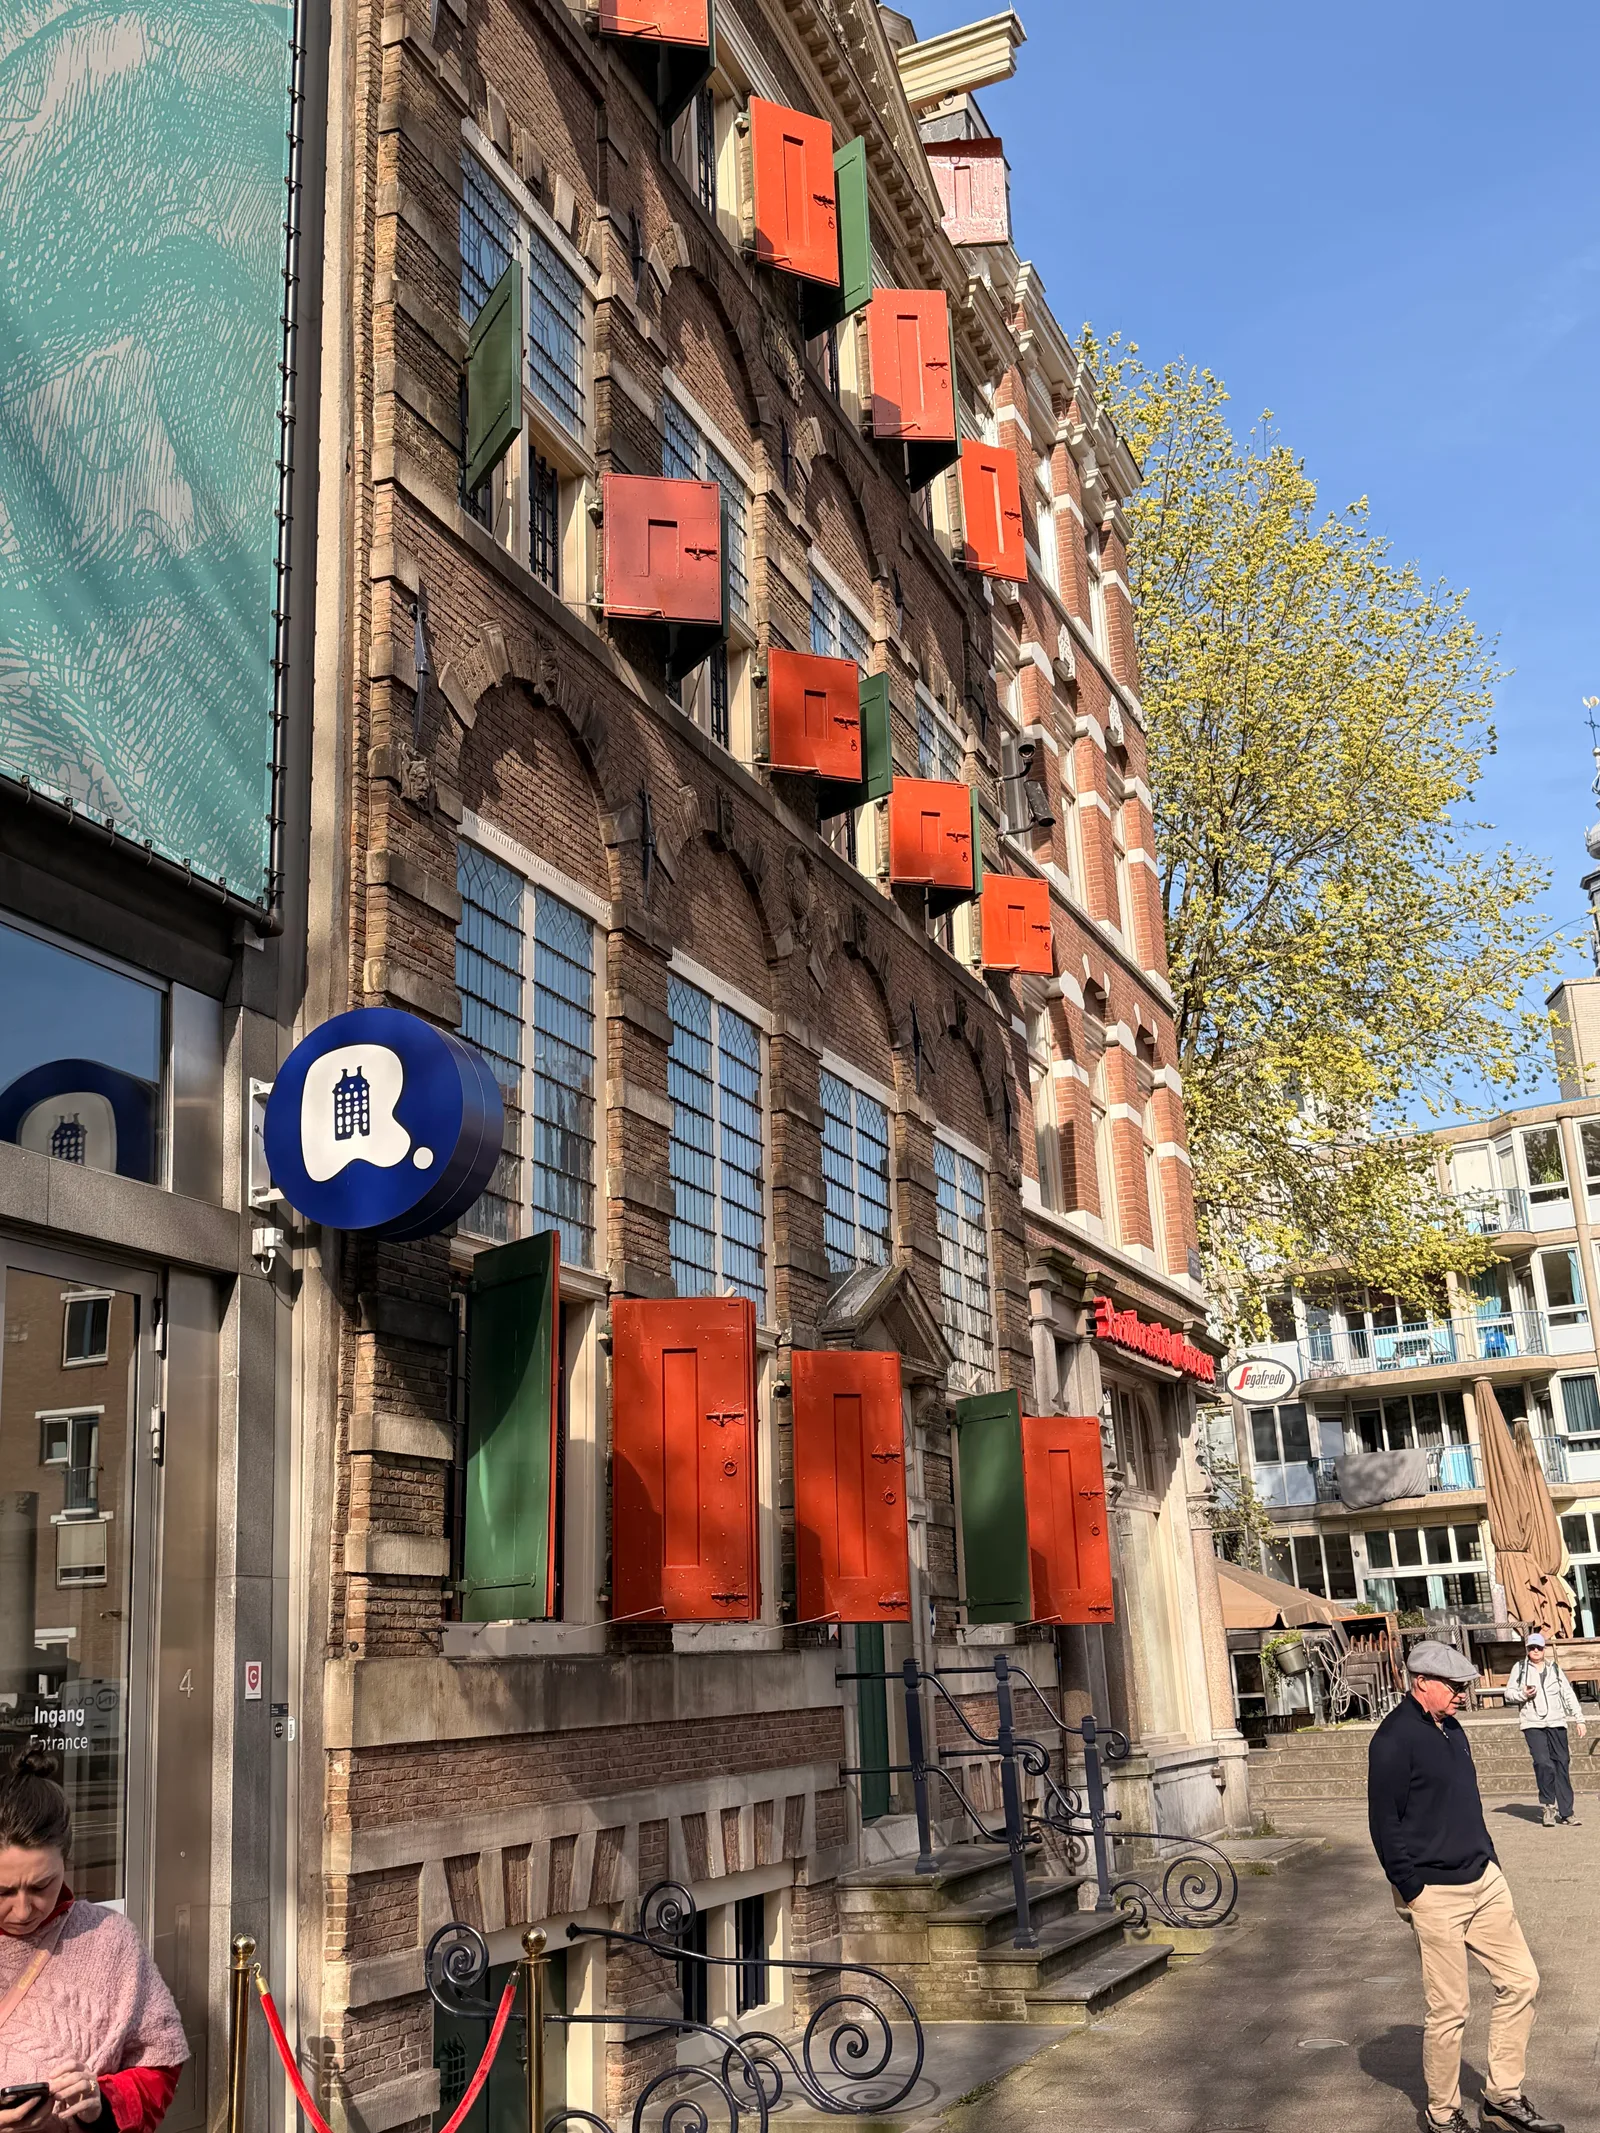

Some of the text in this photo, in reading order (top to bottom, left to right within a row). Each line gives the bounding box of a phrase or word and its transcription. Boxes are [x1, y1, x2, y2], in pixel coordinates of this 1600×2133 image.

[1234, 1366, 1286, 1390] Segafredo
[179, 1668, 194, 1699] 4
[34, 1706, 84, 1728] Ingang
